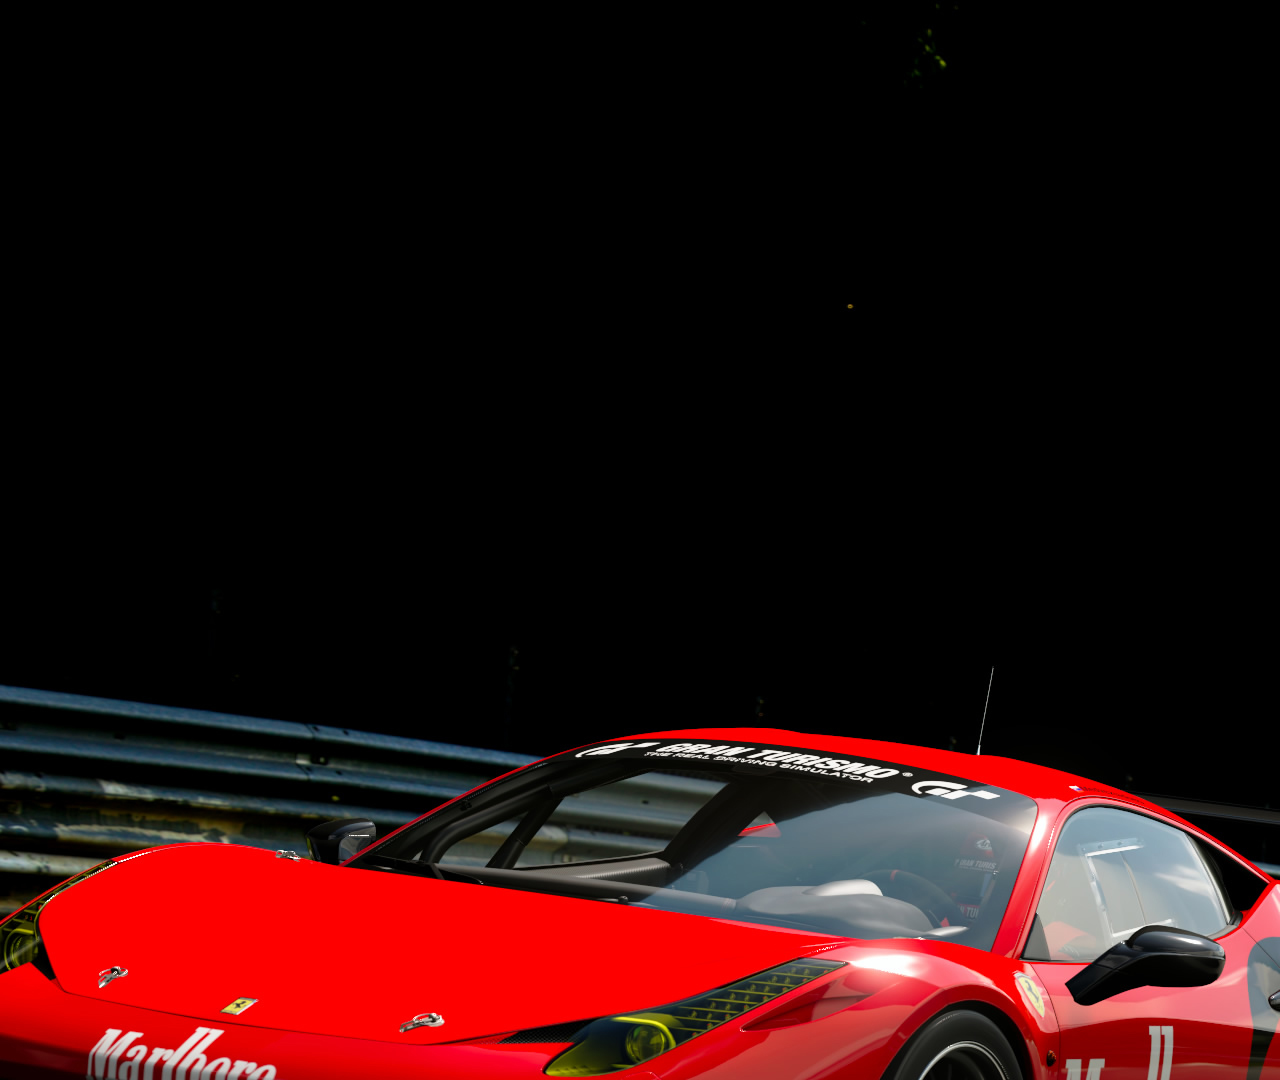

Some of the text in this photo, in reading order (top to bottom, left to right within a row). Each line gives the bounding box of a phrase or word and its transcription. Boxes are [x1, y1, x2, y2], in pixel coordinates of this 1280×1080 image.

[655, 743, 756, 757] GRAN
[672, 752, 710, 760] REAL
[713, 755, 777, 767] DRIVING
[779, 763, 875, 784] SIMULATOR
